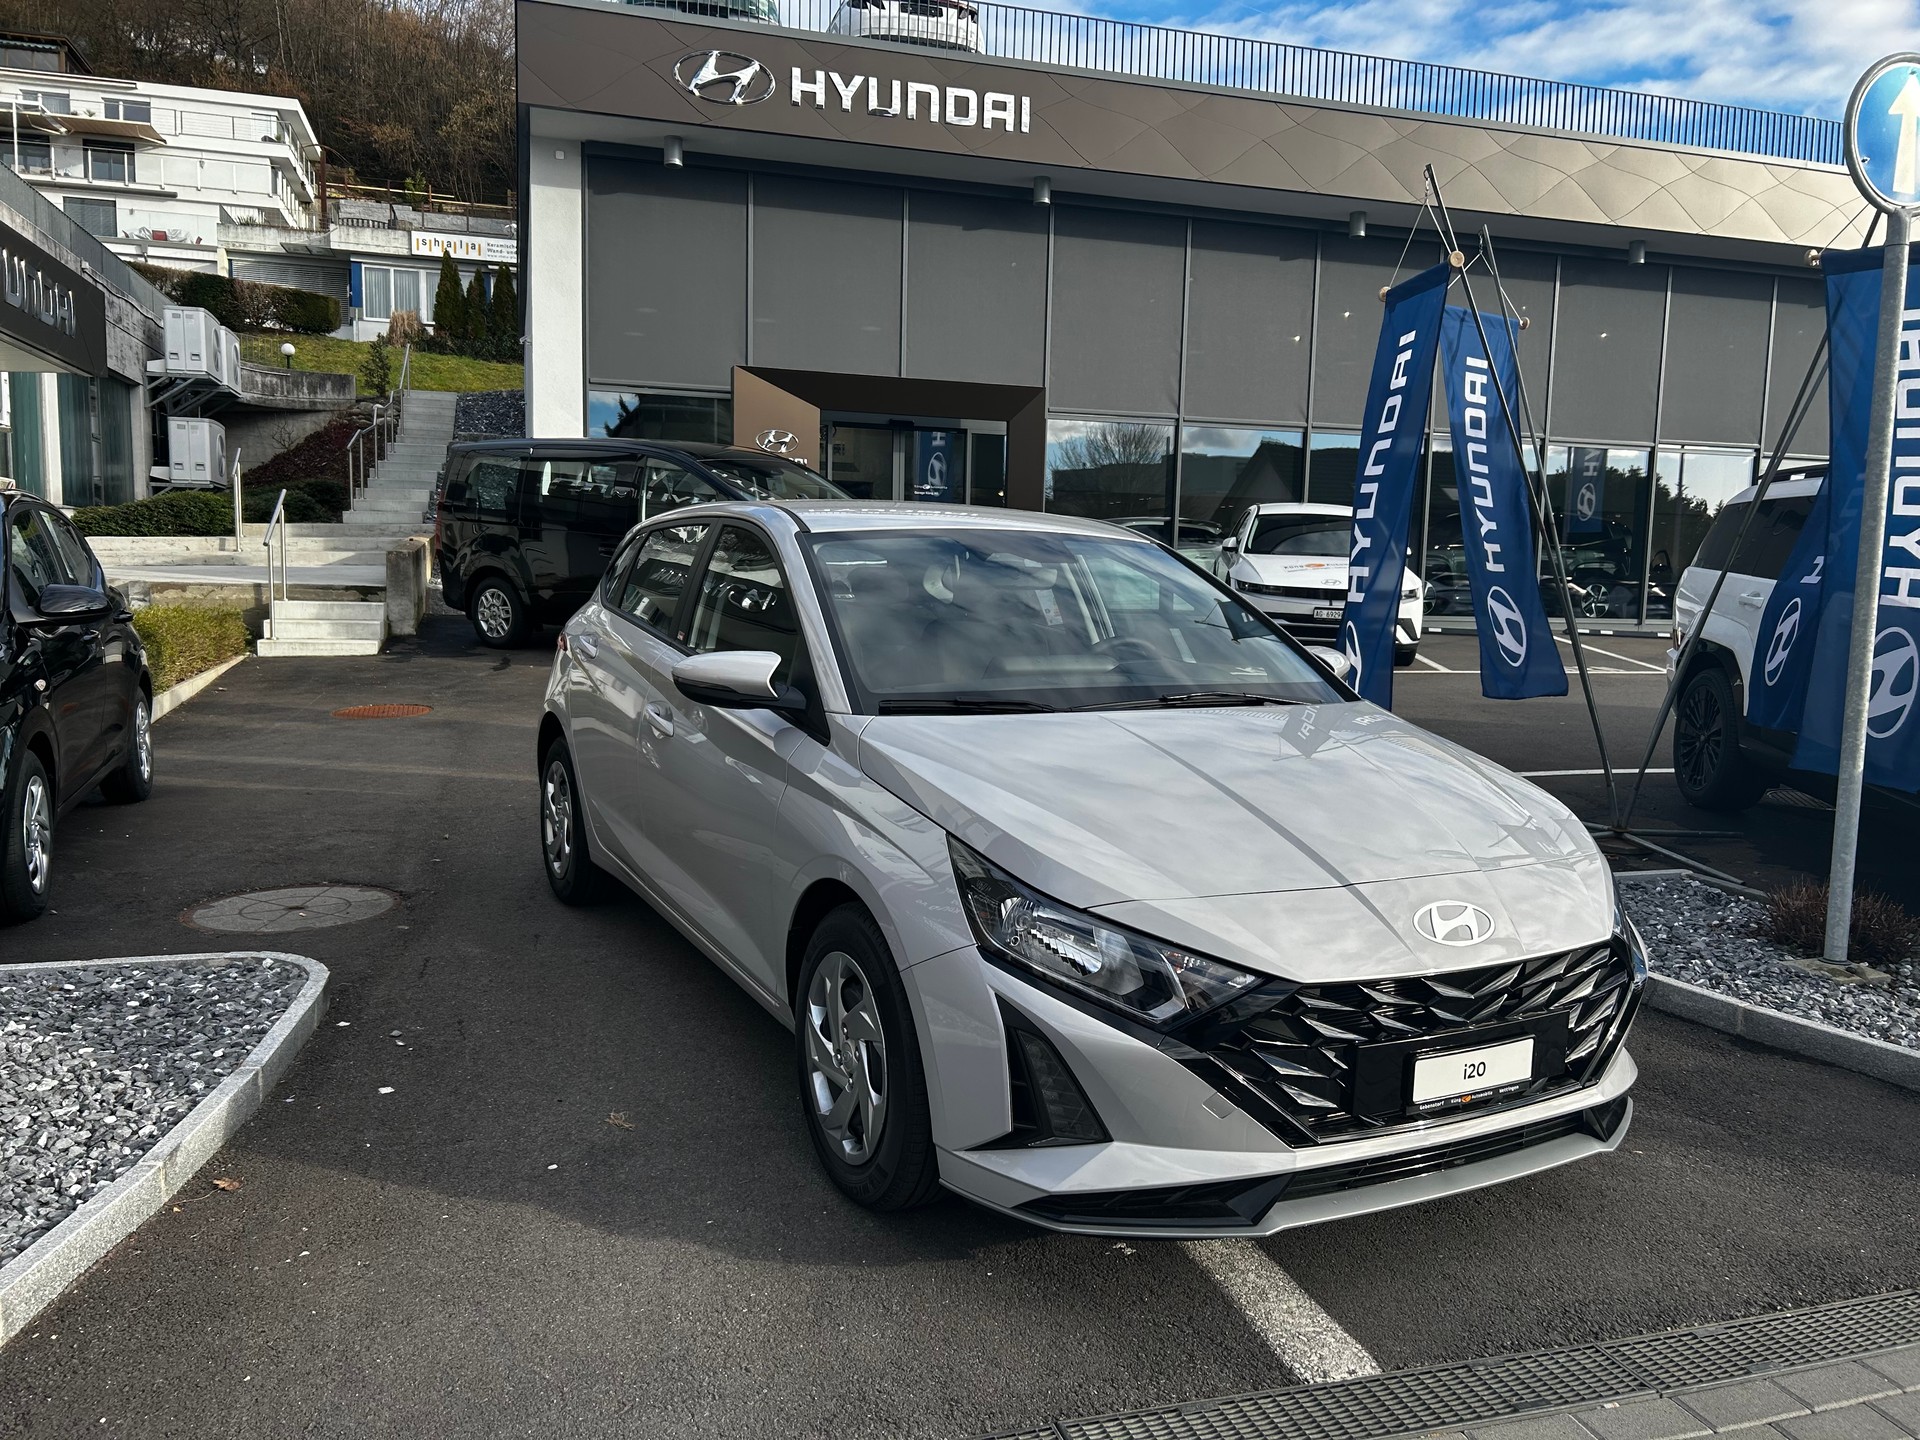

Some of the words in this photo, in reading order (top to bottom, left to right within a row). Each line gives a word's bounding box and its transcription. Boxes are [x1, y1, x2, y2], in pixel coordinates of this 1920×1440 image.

[791, 66, 1031, 134] HYUNDAI
[1347, 329, 1417, 604] HYUNDAI
[1464, 356, 1505, 573] HYUNDAI
[1463, 1061, 1487, 1080] i20
